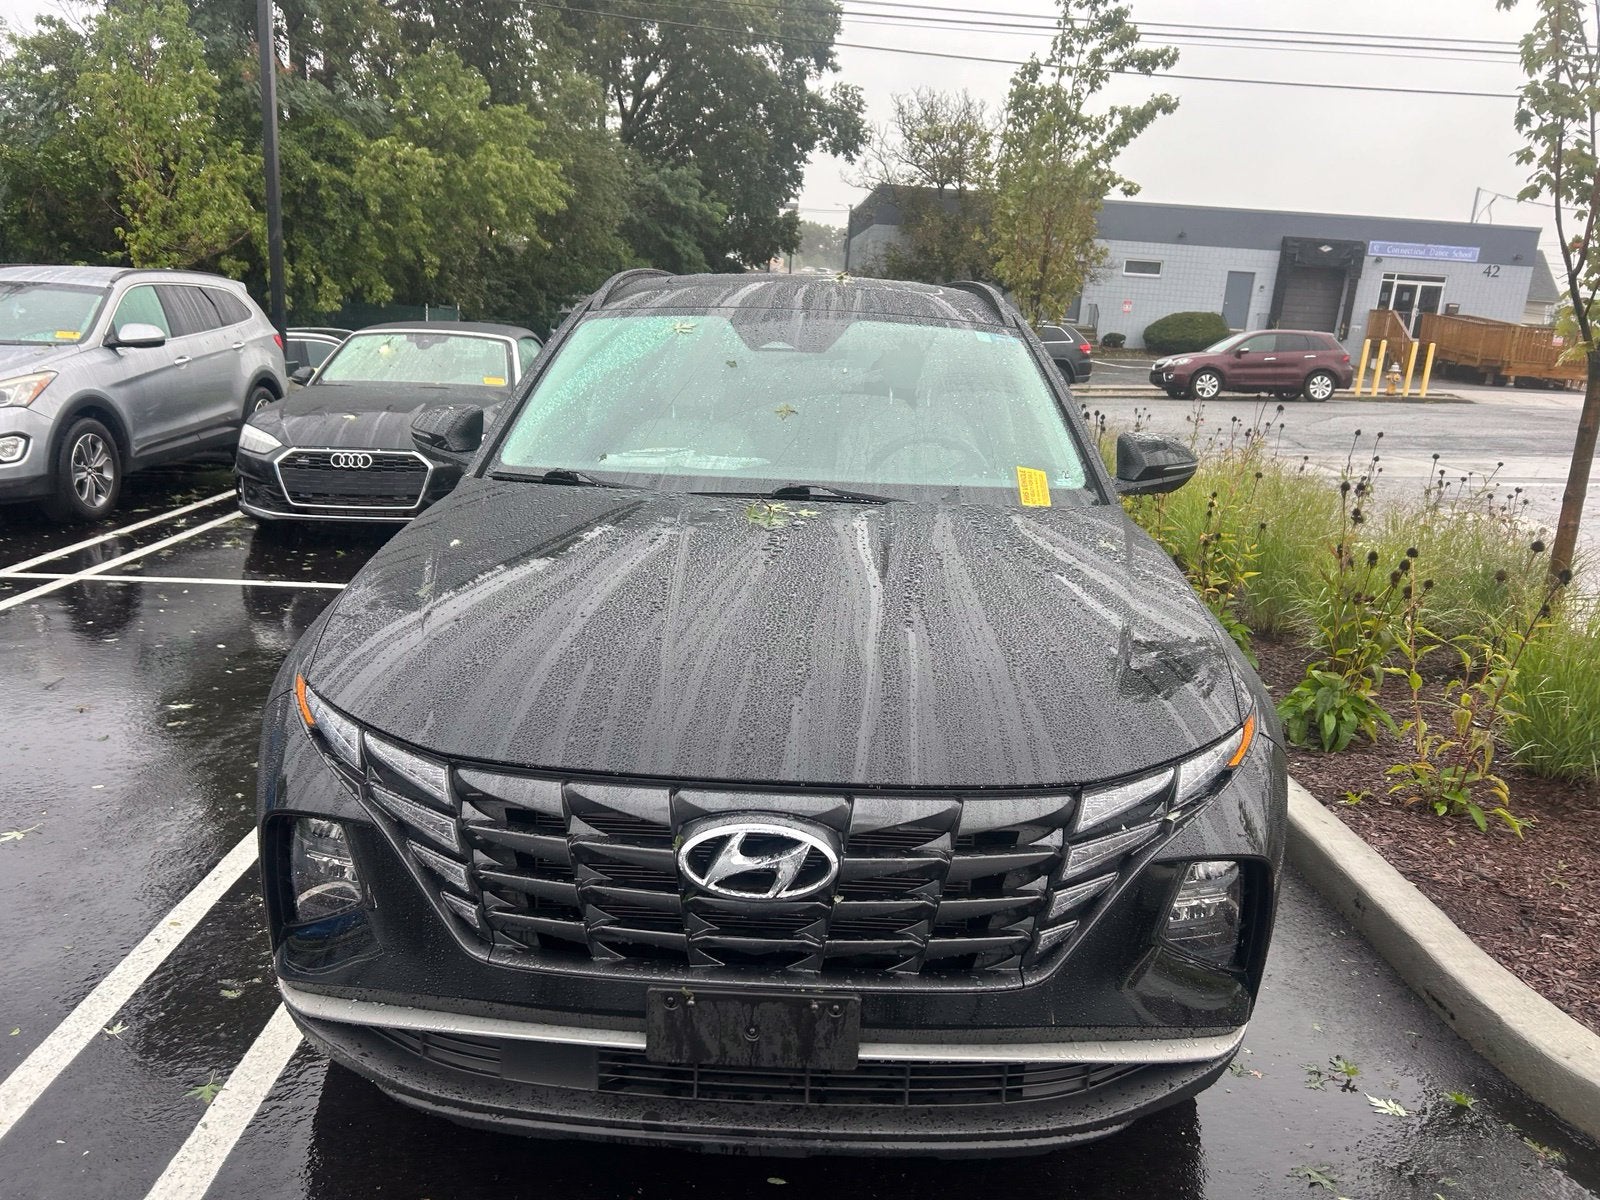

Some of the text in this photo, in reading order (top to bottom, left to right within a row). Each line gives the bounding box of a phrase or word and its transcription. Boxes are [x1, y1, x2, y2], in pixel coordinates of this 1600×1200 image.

[1429, 248, 1449, 257] Dance
[1453, 250, 1473, 258] School
[1482, 265, 1500, 278] 42
